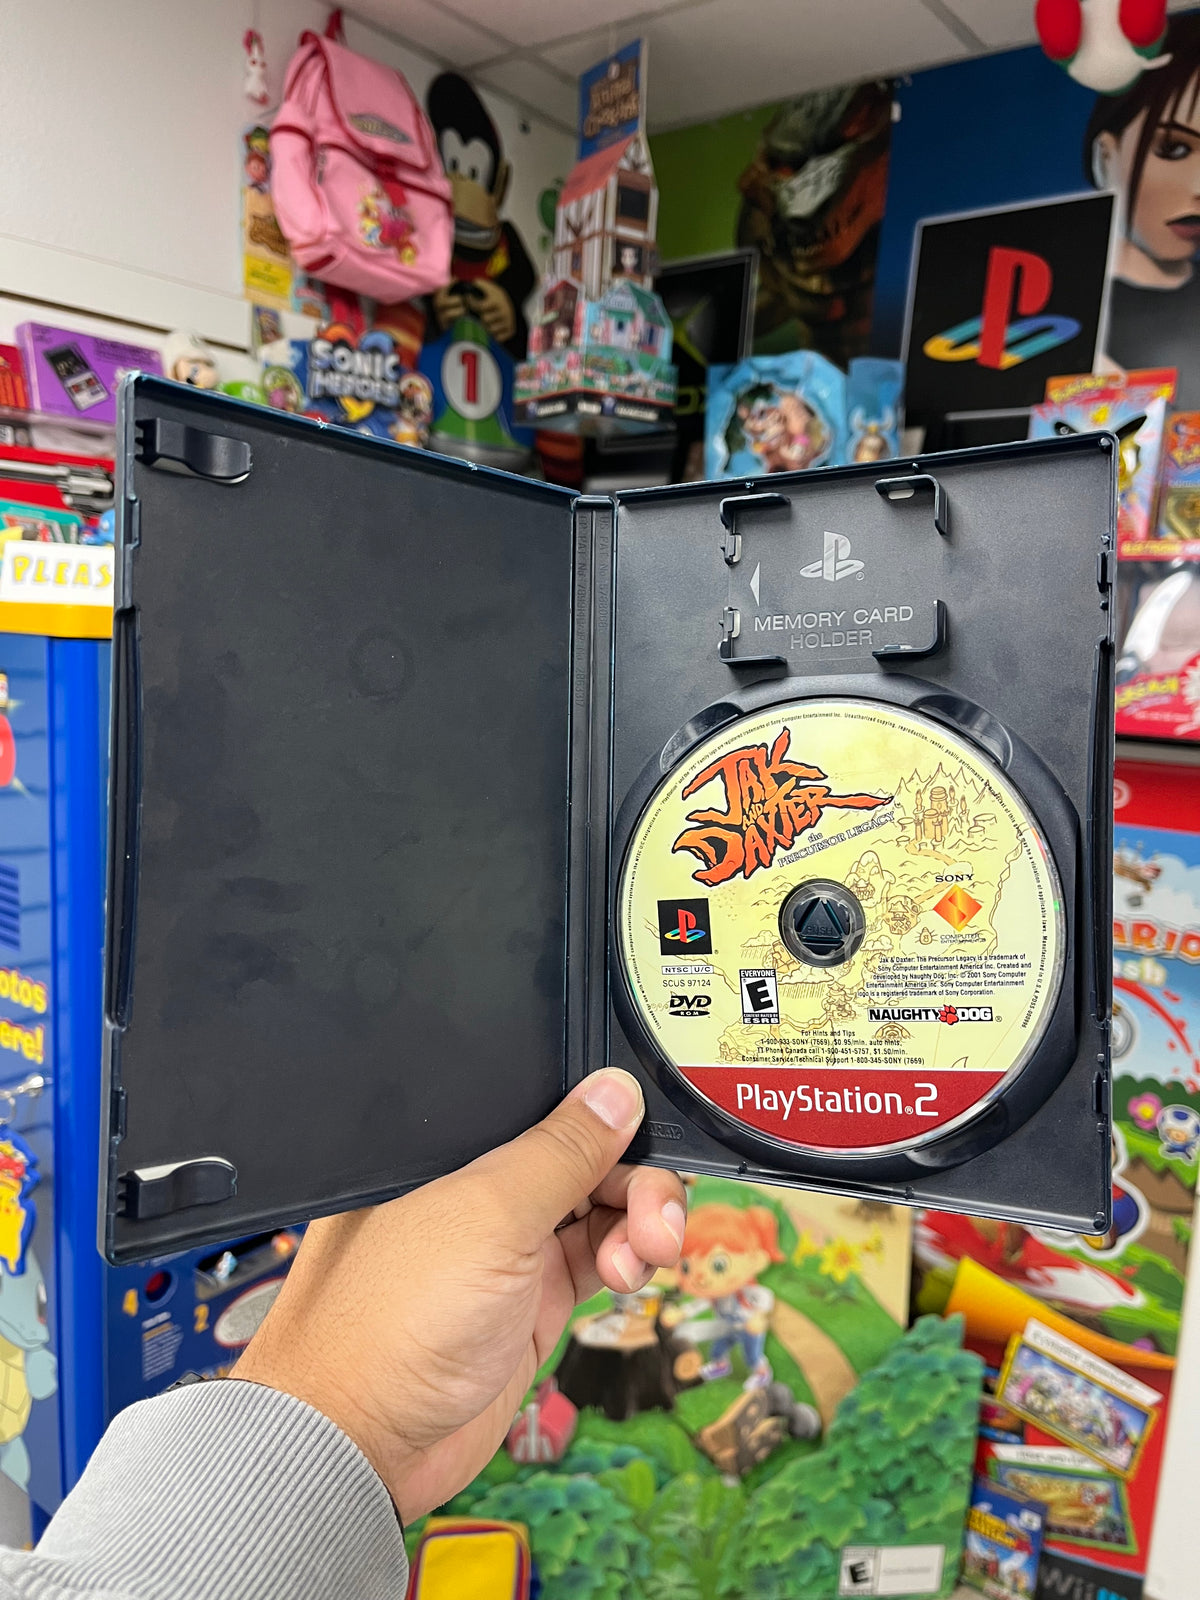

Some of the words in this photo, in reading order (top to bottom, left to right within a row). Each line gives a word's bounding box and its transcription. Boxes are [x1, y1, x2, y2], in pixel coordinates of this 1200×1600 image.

[461, 351, 478, 404] 1
[754, 610, 846, 631] MEMORY
[853, 605, 914, 625] CARD
[790, 629, 873, 649] HOLDER
[682, 727, 829, 825] JAK
[671, 777, 895, 888] DAXTER
[776, 832, 848, 868] PRECURSOR
[846, 810, 896, 841] LEGACY
[935, 873, 975, 883] SONY
[662, 979, 686, 988] SCUS
[687, 979, 711, 987] 97124
[669, 994, 712, 1010] DVD
[745, 979, 774, 1012] E
[869, 1008, 940, 1021] NAUGHTY
[959, 1007, 993, 1021] DOG
[842, 1030, 856, 1038] Tips
[826, 1057, 849, 1065] Support
[903, 1057, 925, 1065] (7669)
[914, 1082, 939, 1117] 2
